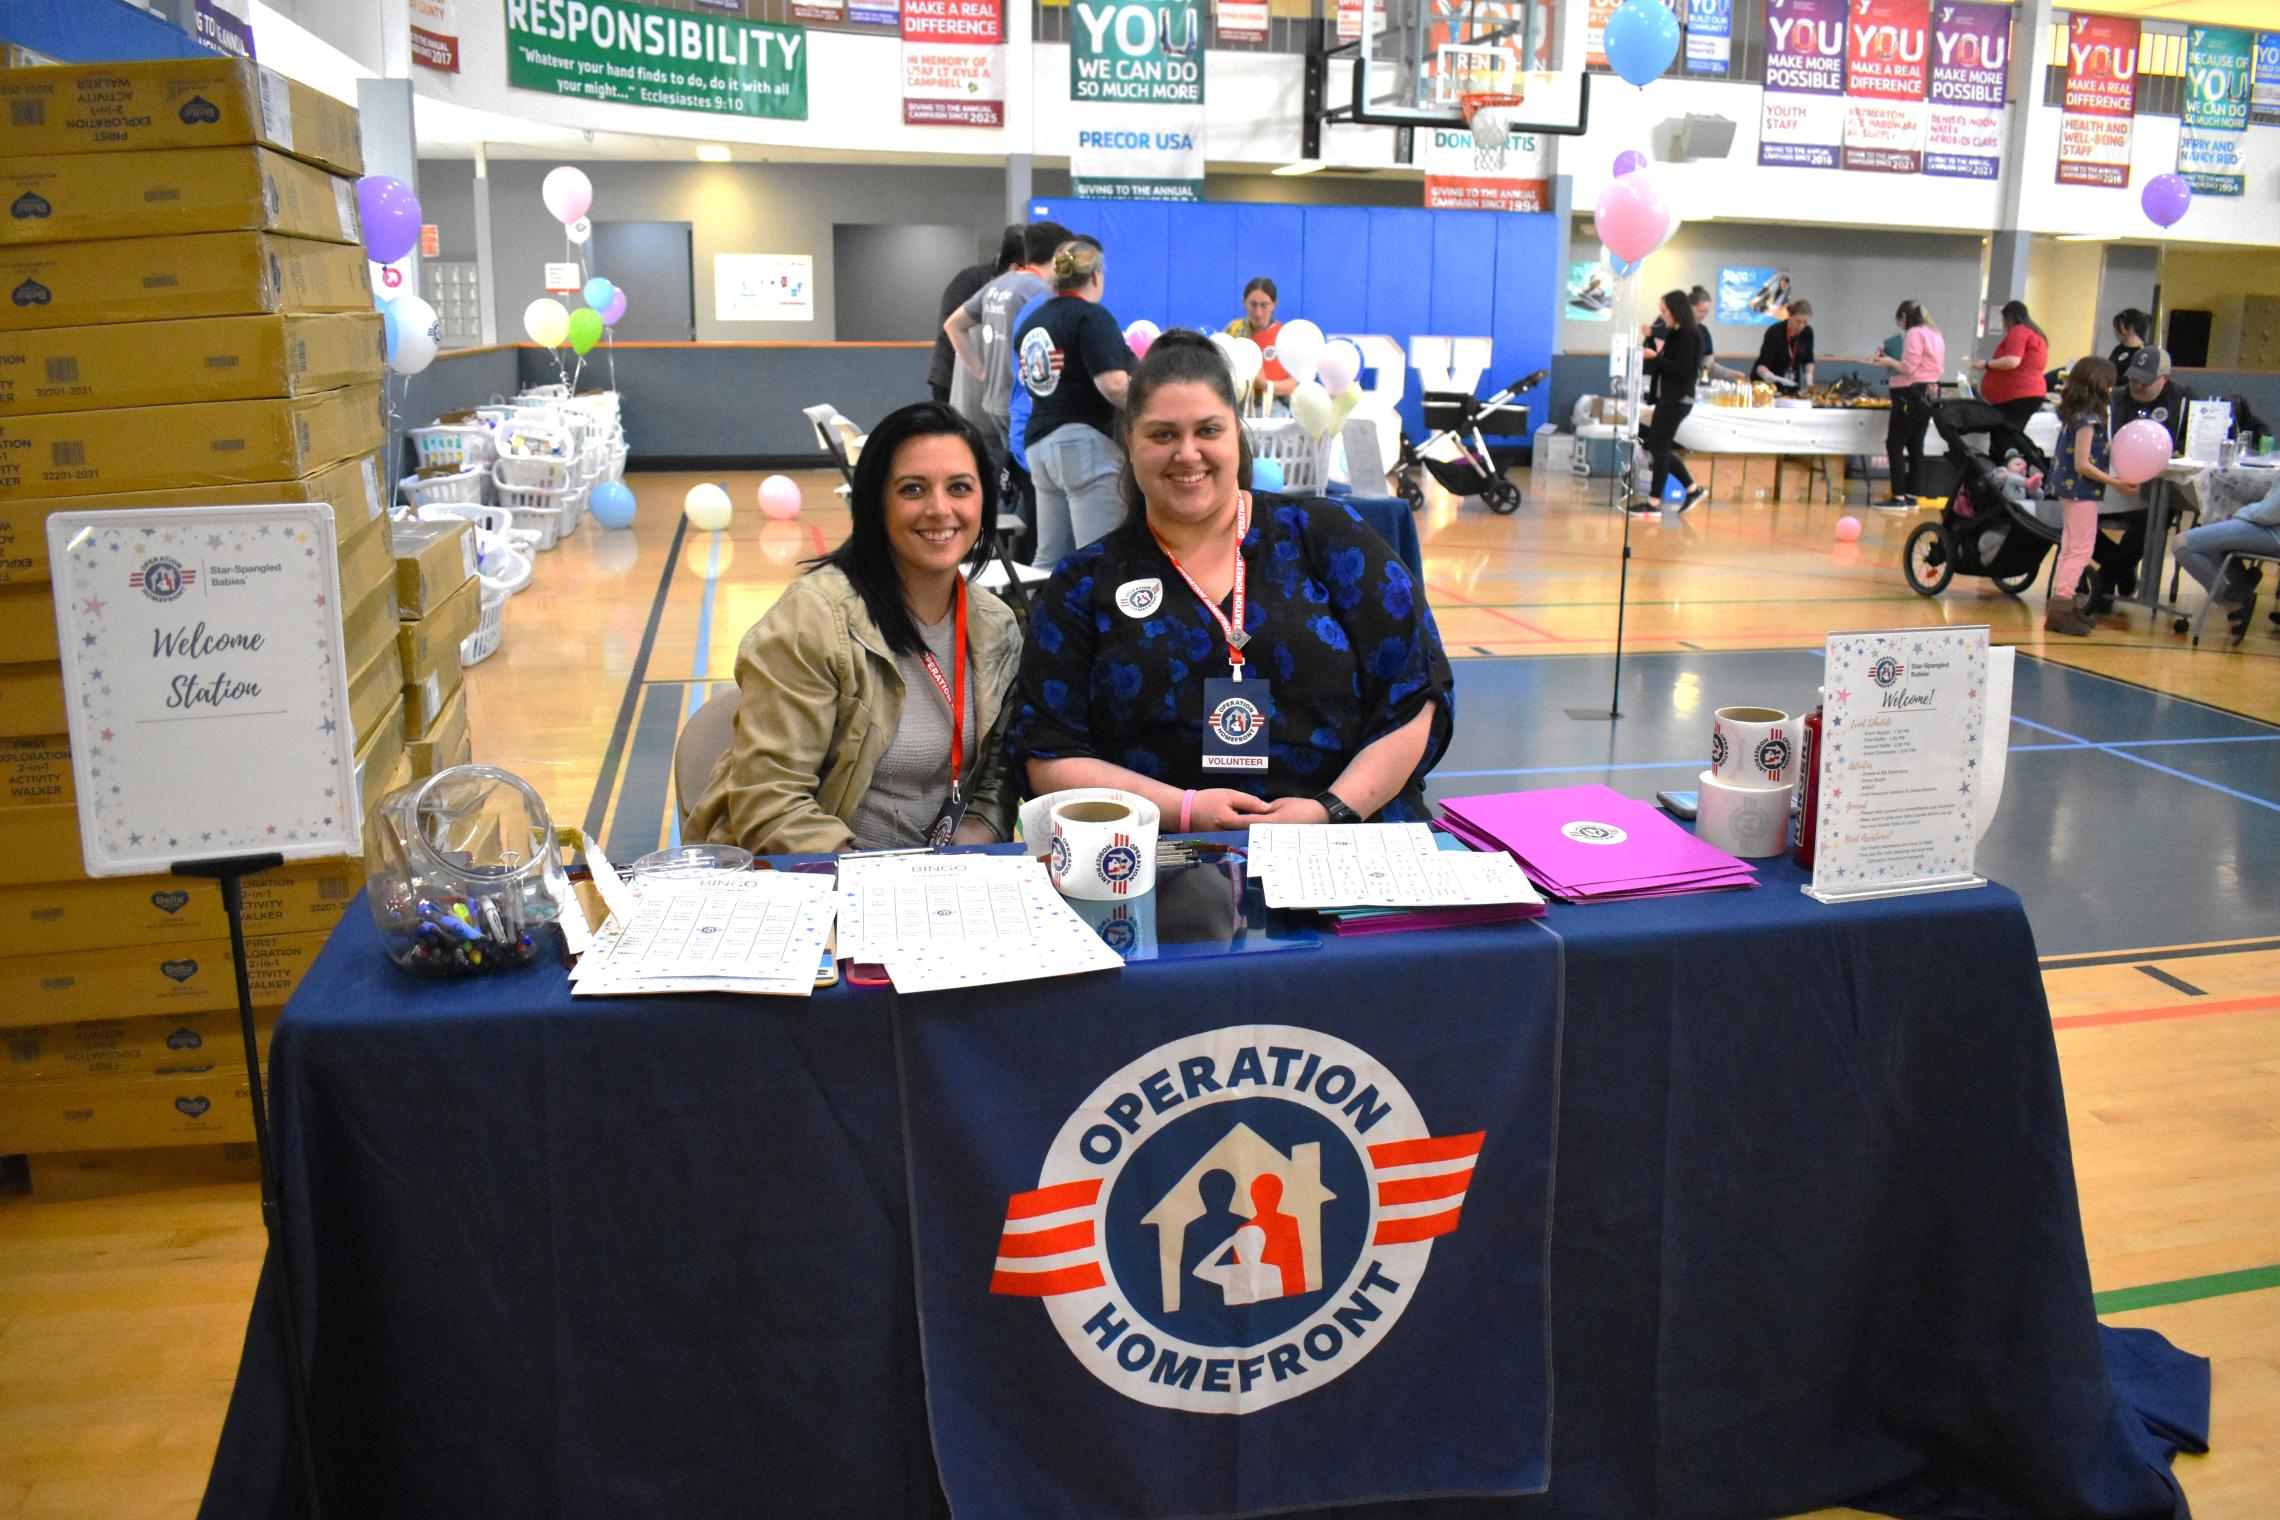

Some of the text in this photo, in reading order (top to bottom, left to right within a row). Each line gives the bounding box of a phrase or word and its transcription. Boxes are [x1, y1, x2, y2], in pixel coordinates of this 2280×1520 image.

[904, 1, 996, 17] MAKE A REAL
[904, 17, 998, 36] DIFFERENCE
[1077, 3, 1198, 57] YOU
[508, 0, 801, 70] RESPONSIBILITY
[1769, 16, 1843, 55] YOU
[1853, 24, 1925, 62] YOU
[432, 50, 452, 65] 2017
[1936, 31, 2005, 69] YOU
[921, 56, 970, 66] MEMORY
[1767, 54, 1841, 71] MAKE MORE
[2070, 43, 2136, 80] YOU
[2188, 52, 2249, 69] BECAUSE OF
[952, 67, 980, 78] KYLE
[1078, 59, 1198, 82] WE CAN DO
[1851, 61, 1922, 77] MAKE A REAL
[1934, 67, 2003, 84] MAKE MORE
[578, 60, 604, 75] your
[607, 61, 634, 79] hand
[638, 66, 667, 83] finds
[670, 70, 684, 85] to
[687, 74, 707, 90] do,
[710, 76, 726, 90] do
[729, 78, 739, 91] it
[742, 79, 771, 94] with
[774, 83, 789, 95] all
[1766, 68, 1841, 89] POSSIBLE
[1850, 77, 1922, 93] DIFFERENCE
[2188, 67, 2249, 102] YOU
[557, 78, 581, 93] your
[640, 87, 712, 108] Ecclesiastes
[714, 97, 744, 111] 9:10
[1078, 82, 1198, 99] SO MUCH MORE
[1932, 81, 2003, 102] POSSIBLE
[2067, 79, 2132, 95] MAKE A REAL
[77, 92, 133, 103] ACTIVITY
[2066, 92, 2132, 110] DIFFERENCE
[1766, 105, 1807, 117] YOUTH
[2186, 101, 2247, 117] WE CAN DO
[66, 116, 152, 129] EXPLORATION
[969, 113, 997, 124] 2025
[1766, 118, 1799, 130] STAFF
[2065, 119, 2128, 134] HEALTH AND
[2184, 114, 2247, 128] SO MUCH MORE
[93, 131, 128, 142] FIRST
[1079, 131, 1193, 150] PRECOR USA
[1435, 132, 1472, 148] DON
[2064, 132, 2124, 147] WELL-BEING
[2063, 144, 2093, 156] STAFF
[2212, 141, 2234, 152] AND
[1078, 184, 1194, 197] GIVING TO THE ANNUAL
[1466, 187, 1479, 197] TO
[1481, 188, 1497, 198] THE
[1508, 199, 1540, 212] 1994
[37, 385, 93, 397] 32201-2031
[141, 555, 183, 571] OPERATION
[210, 563, 281, 576] Star-Spangled
[152, 621, 265, 659] Welcome
[921, 651, 952, 703] OPERATION
[166, 672, 263, 709] Station
[1882, 688, 1935, 709] Welcome!
[1218, 700, 1255, 713] OPERATION
[1217, 727, 1256, 743] HOMEFRONT
[1208, 757, 1263, 766] VOLUNTEER
[9, 774, 61, 784] ACTIVITY
[11, 786, 62, 796] WALKER
[912, 864, 967, 873] BINGO
[1096, 844, 1113, 885] HOMEFRONT
[1130, 843, 1142, 882] OPERATION
[700, 879, 758, 888] BINGO
[246, 938, 277, 948] FIRST
[248, 969, 291, 979] CTIVITY
[1079, 1046, 1392, 1165] OPERATION
[1082, 1260, 1400, 1394] HOMEFRONT
